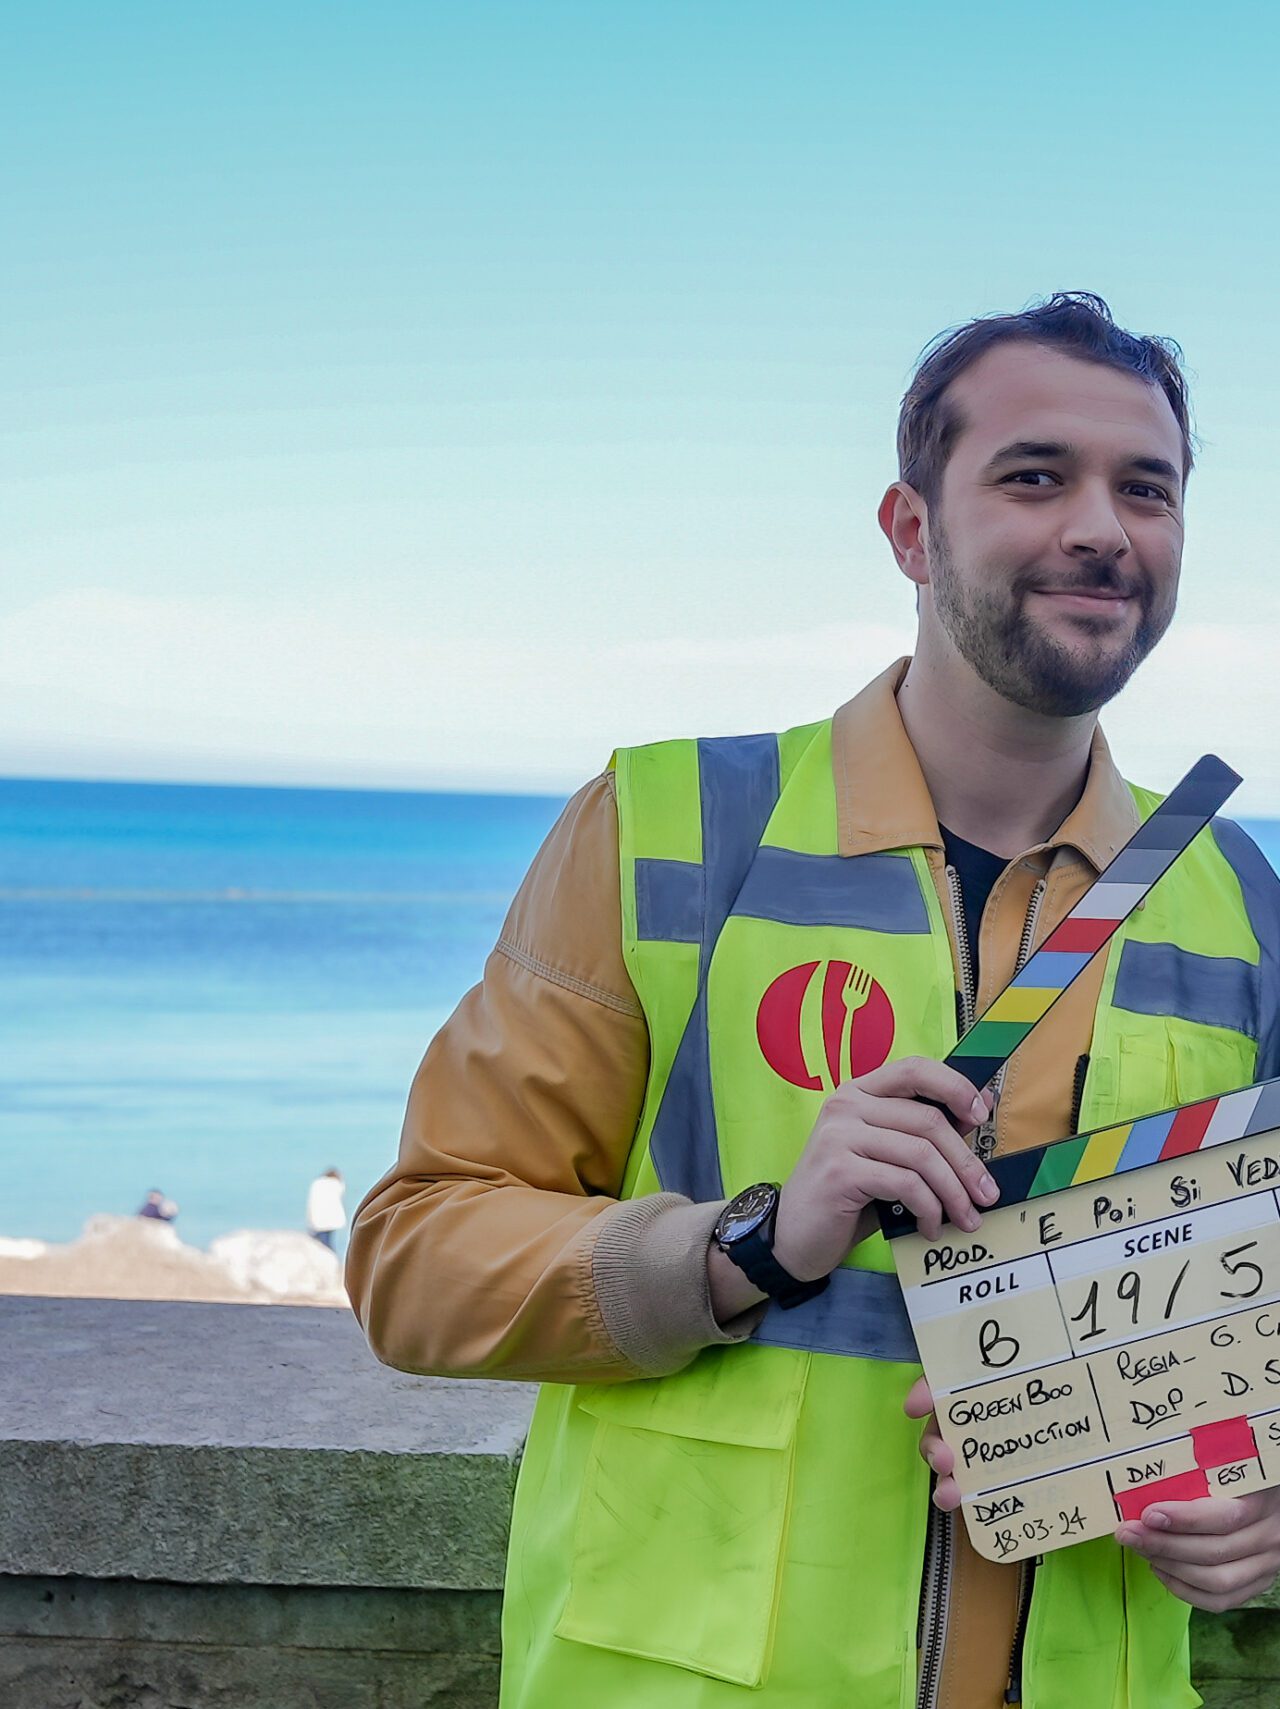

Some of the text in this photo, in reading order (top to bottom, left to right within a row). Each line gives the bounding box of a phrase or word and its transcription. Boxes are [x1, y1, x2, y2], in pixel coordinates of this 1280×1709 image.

[1124, 1223, 1193, 1257] SCENE
[924, 1244, 994, 1275] PROD.
[959, 1272, 1019, 1303] ROLL
[979, 1319, 1020, 1368] B
[1210, 1325, 1242, 1347] G.
[1221, 1372, 1254, 1397] D.
[1126, 1459, 1166, 1483] DAY
[1217, 1464, 1249, 1486] EST
[972, 1496, 1025, 1524] DATA
